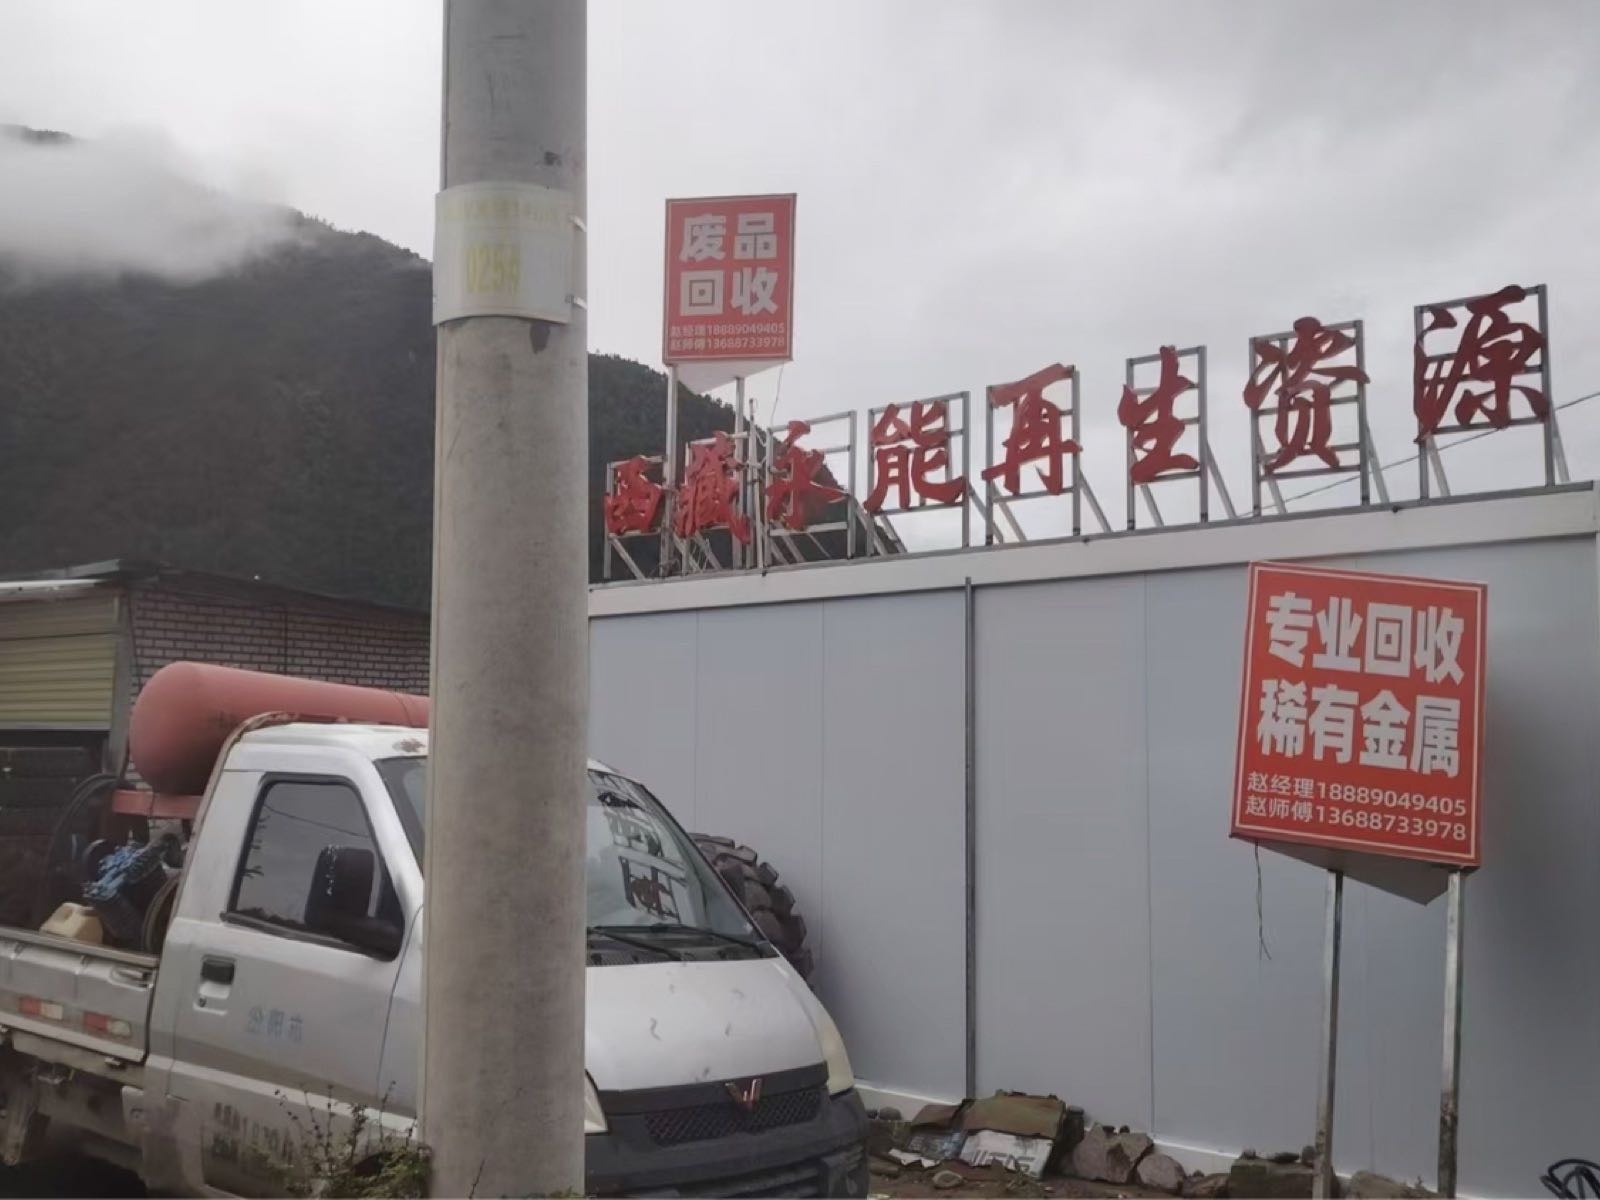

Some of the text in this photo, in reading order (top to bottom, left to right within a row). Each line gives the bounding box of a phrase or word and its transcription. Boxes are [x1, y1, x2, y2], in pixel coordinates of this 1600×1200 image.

[679, 212, 778, 262] 废品
[679, 266, 779, 317] 回收
[1265, 591, 1465, 686] 专业回收
[1256, 678, 1462, 778] 稀有金属
[1245, 795, 1467, 841] 赵师傅13688733978
[1247, 771, 1467, 817] 赵经理18889049405
